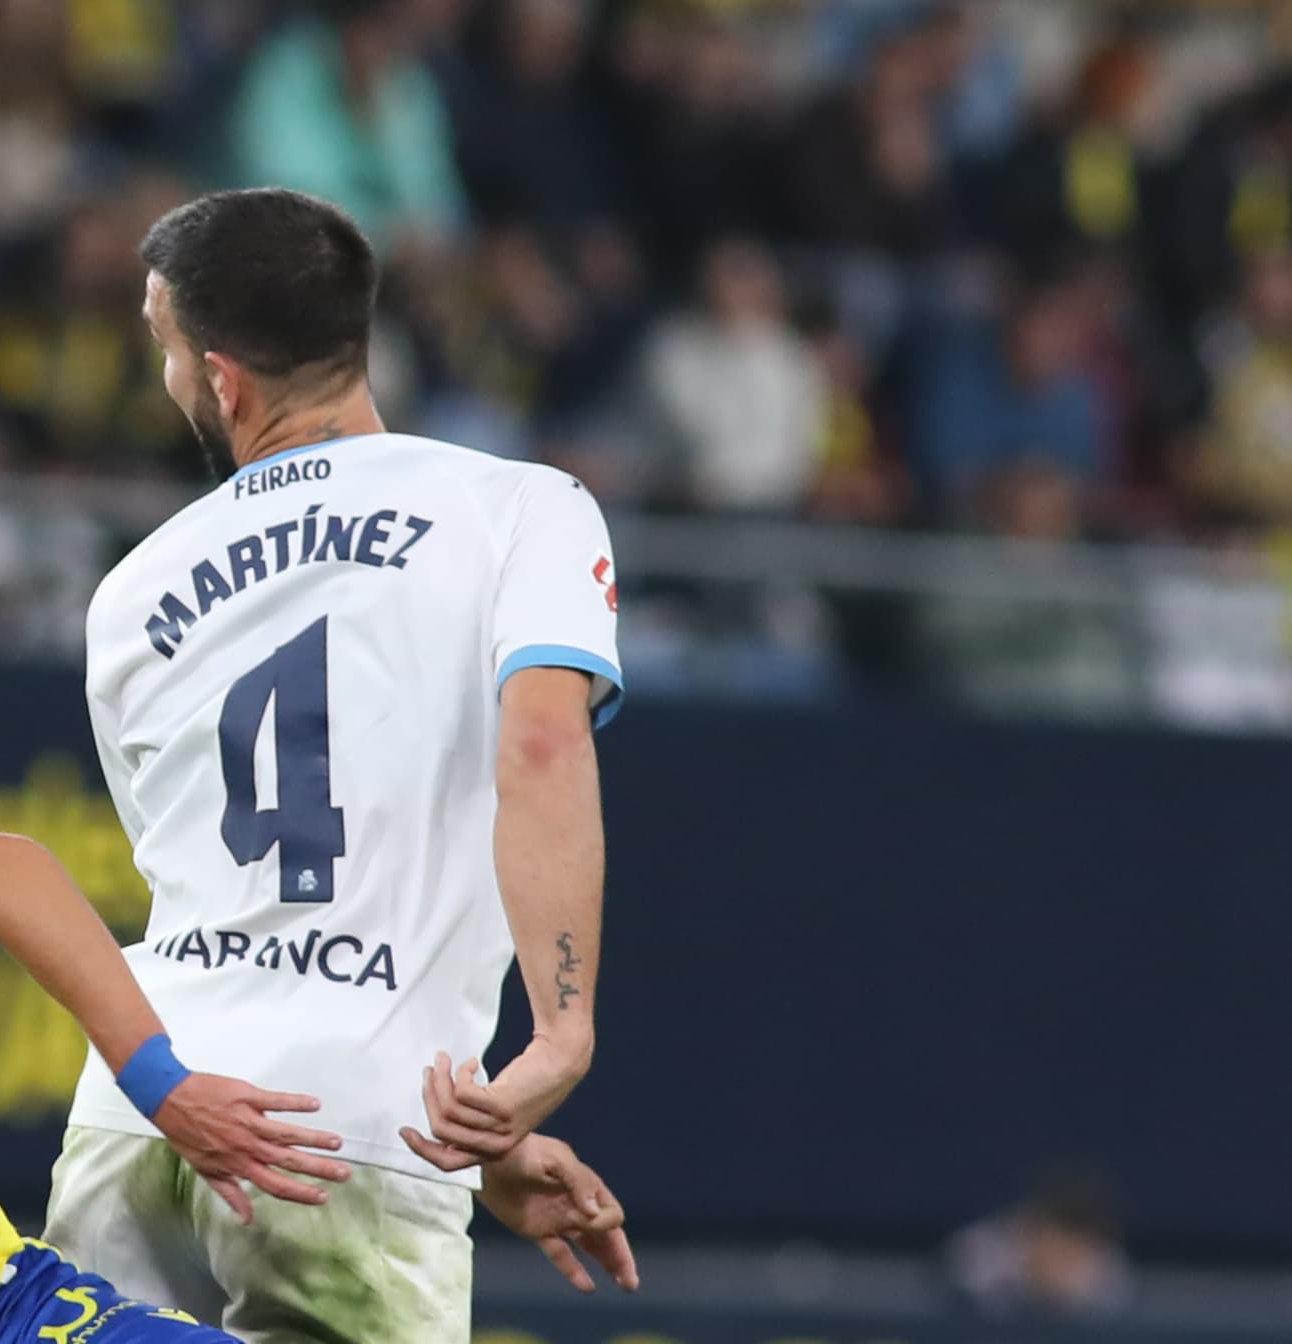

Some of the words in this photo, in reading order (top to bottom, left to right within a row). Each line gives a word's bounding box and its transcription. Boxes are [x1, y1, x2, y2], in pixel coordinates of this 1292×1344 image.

[234, 457, 332, 500] FEIRACO
[144, 503, 434, 662] MARTÍNEZ
[218, 613, 346, 903] 4
